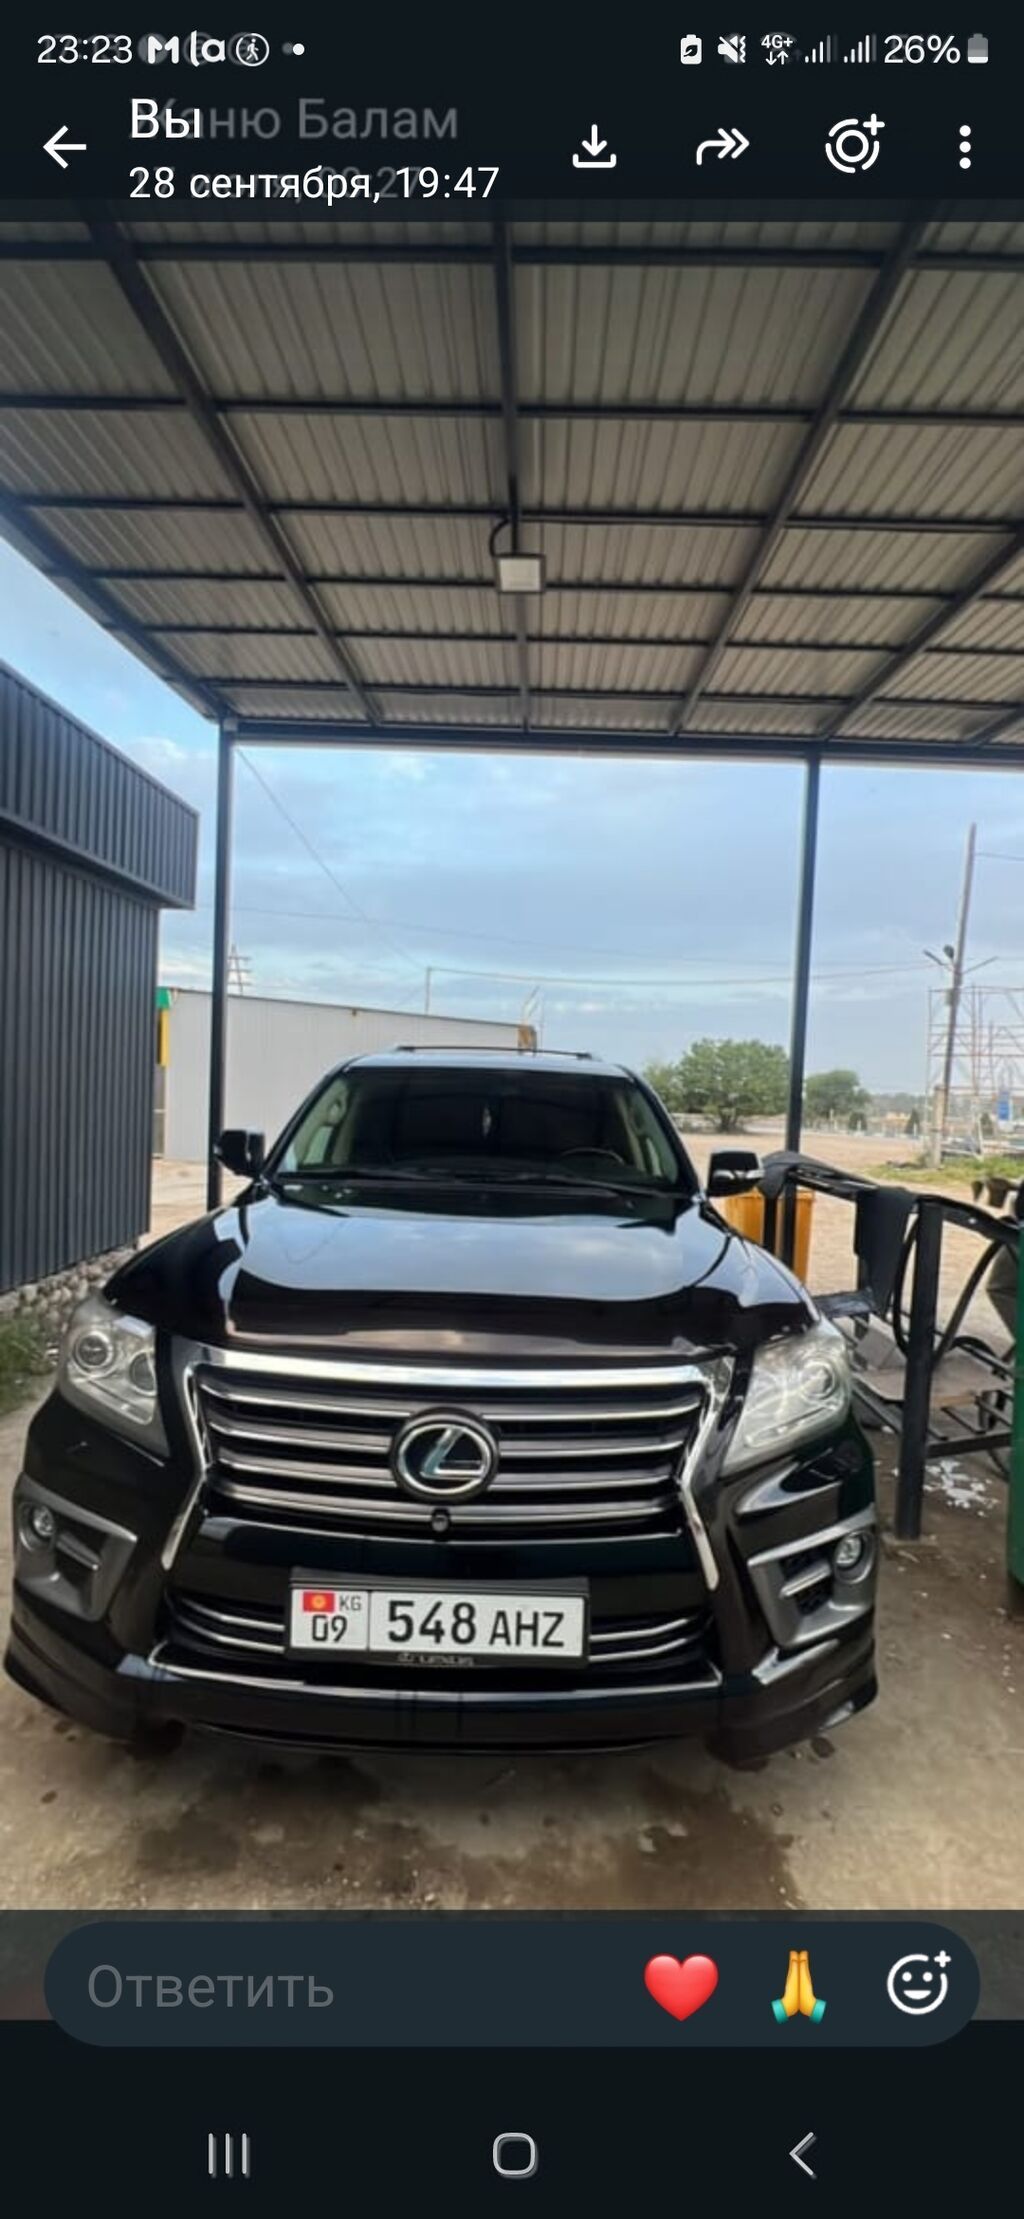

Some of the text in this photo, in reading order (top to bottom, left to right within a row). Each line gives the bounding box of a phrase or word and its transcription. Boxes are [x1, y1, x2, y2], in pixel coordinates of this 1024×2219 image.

[339, 1595, 362, 1611] KG
[312, 1614, 348, 1643] 09
[387, 1600, 565, 1648] 548 AHZ
